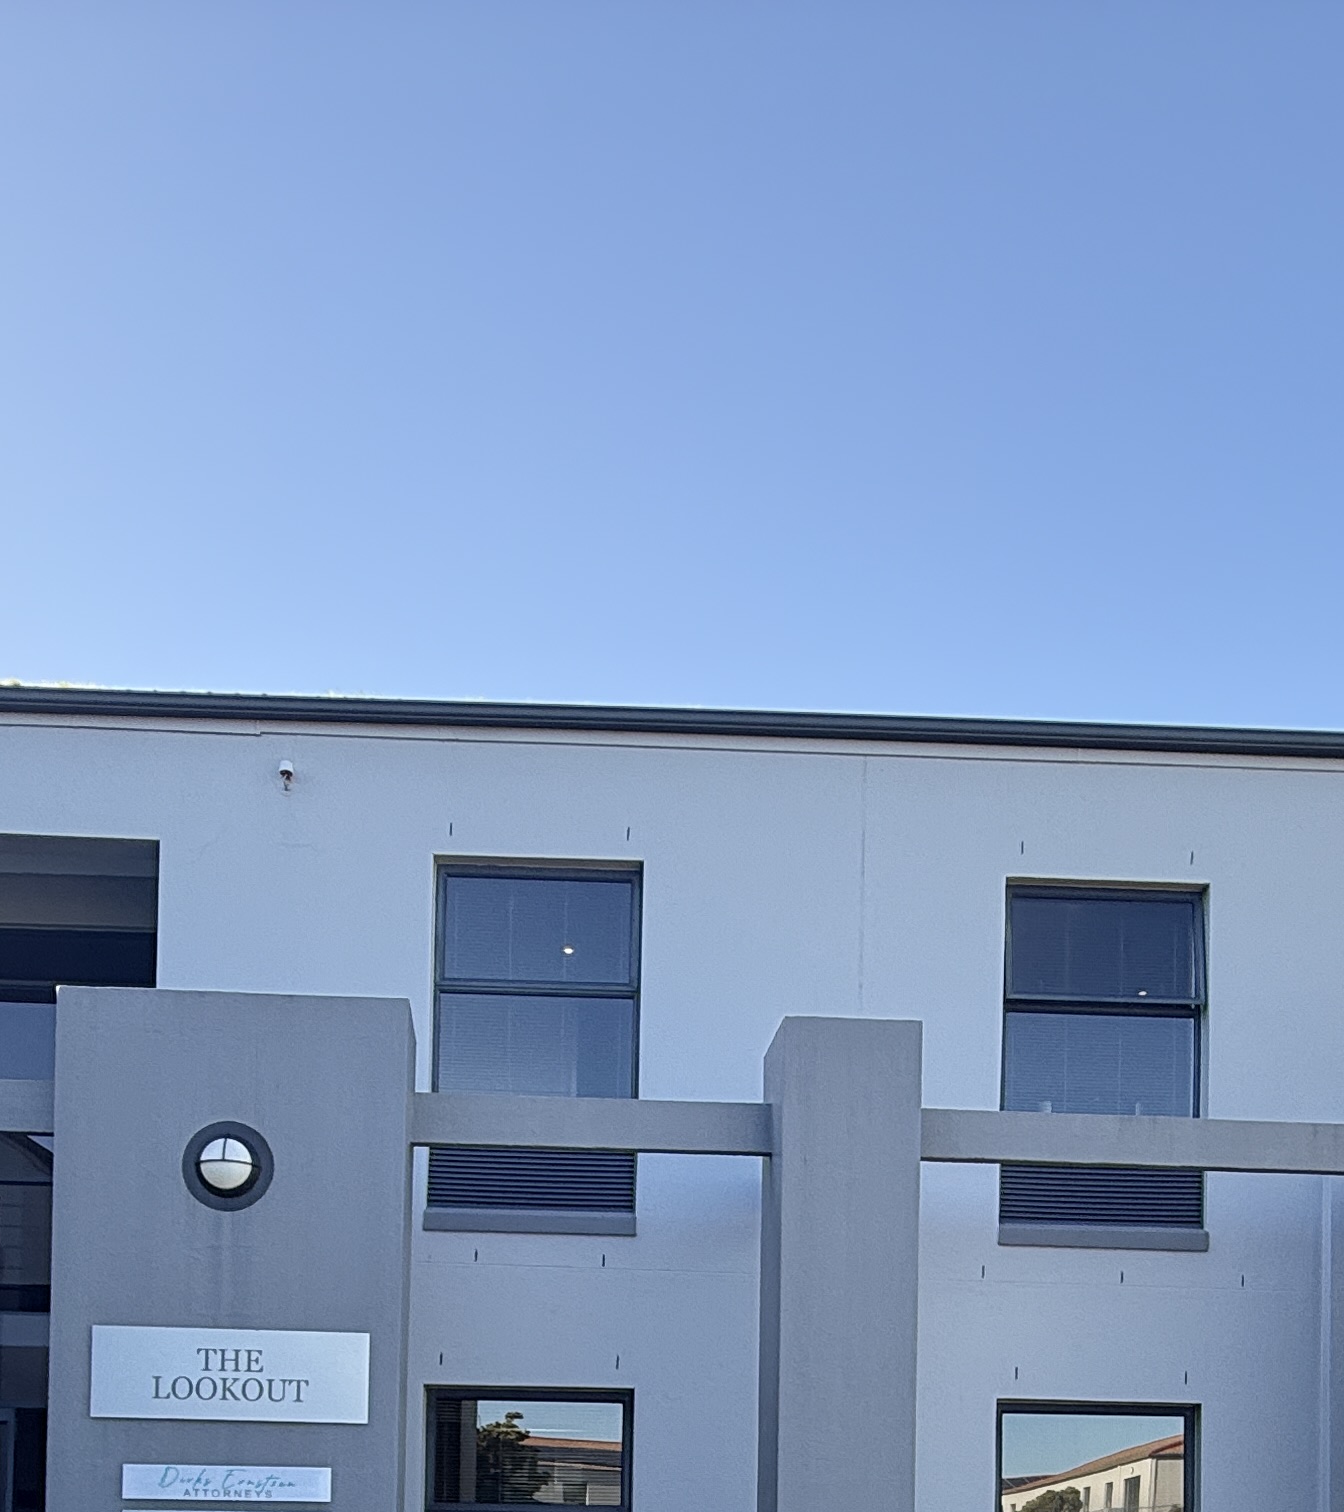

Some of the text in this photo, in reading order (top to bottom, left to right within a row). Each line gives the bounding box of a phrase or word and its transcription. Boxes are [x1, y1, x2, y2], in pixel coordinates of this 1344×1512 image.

[196, 1347, 264, 1373] THE
[151, 1375, 310, 1403] LOOKOUT
[183, 1488, 273, 1499] ATTORNEYS
